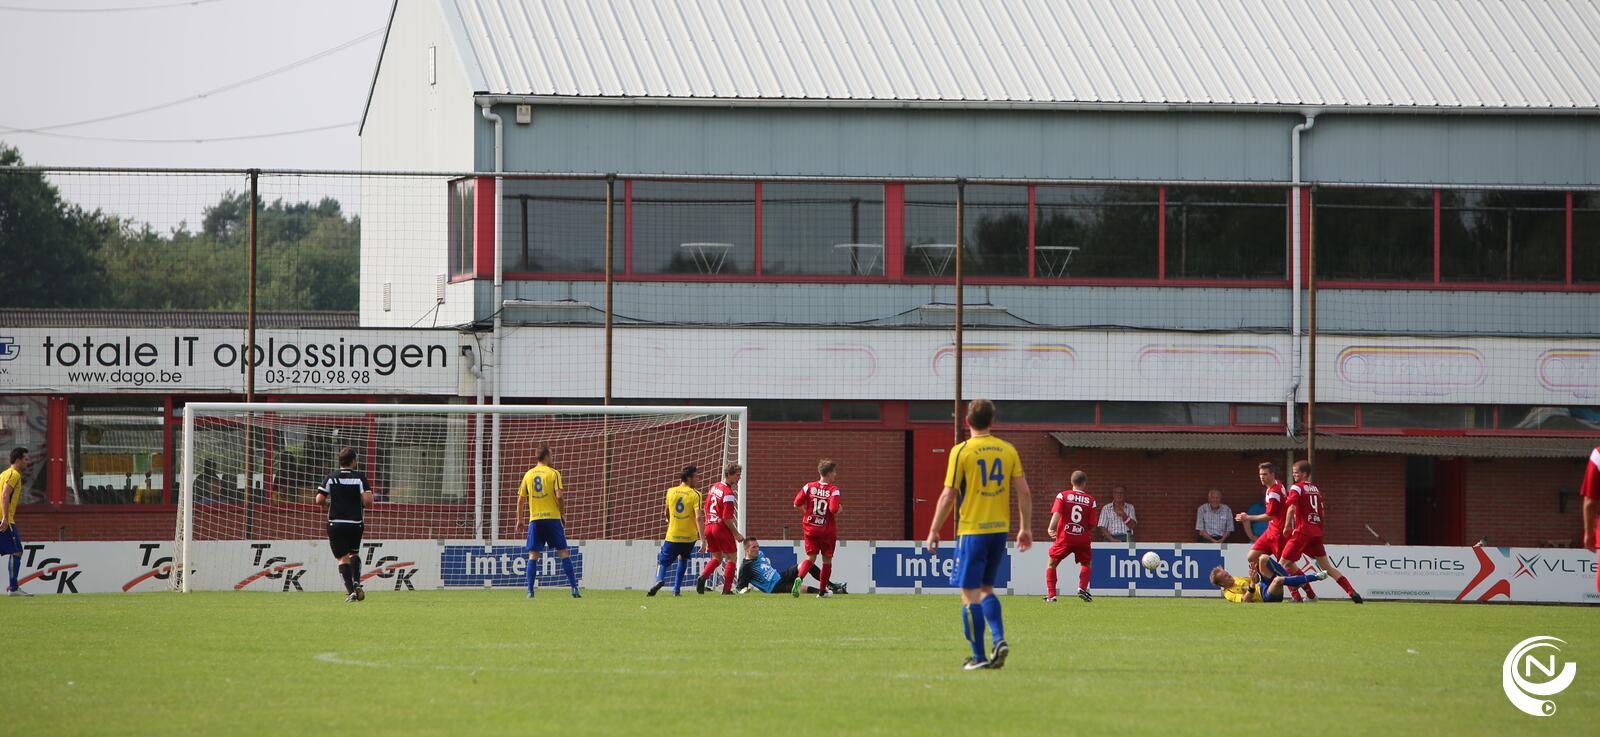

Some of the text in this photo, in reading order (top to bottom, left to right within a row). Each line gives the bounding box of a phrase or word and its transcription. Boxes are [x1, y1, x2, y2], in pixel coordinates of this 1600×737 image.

[43, 336, 158, 366] totale
[174, 336, 199, 366] IT
[213, 337, 447, 376] oplossingen
[68, 369, 182, 386] www.dago.be
[265, 370, 370, 384] 03-270.98.98
[977, 457, 1004, 487] 14
[533, 475, 543, 493] 8
[675, 497, 685, 513] 6
[709, 496, 718, 514] 2
[812, 497, 828, 515] 10
[1309, 495, 1318, 513] 4
[1070, 504, 1083, 524] 6
[896, 553, 954, 577] Imte
[1362, 556, 1465, 571] Technics
